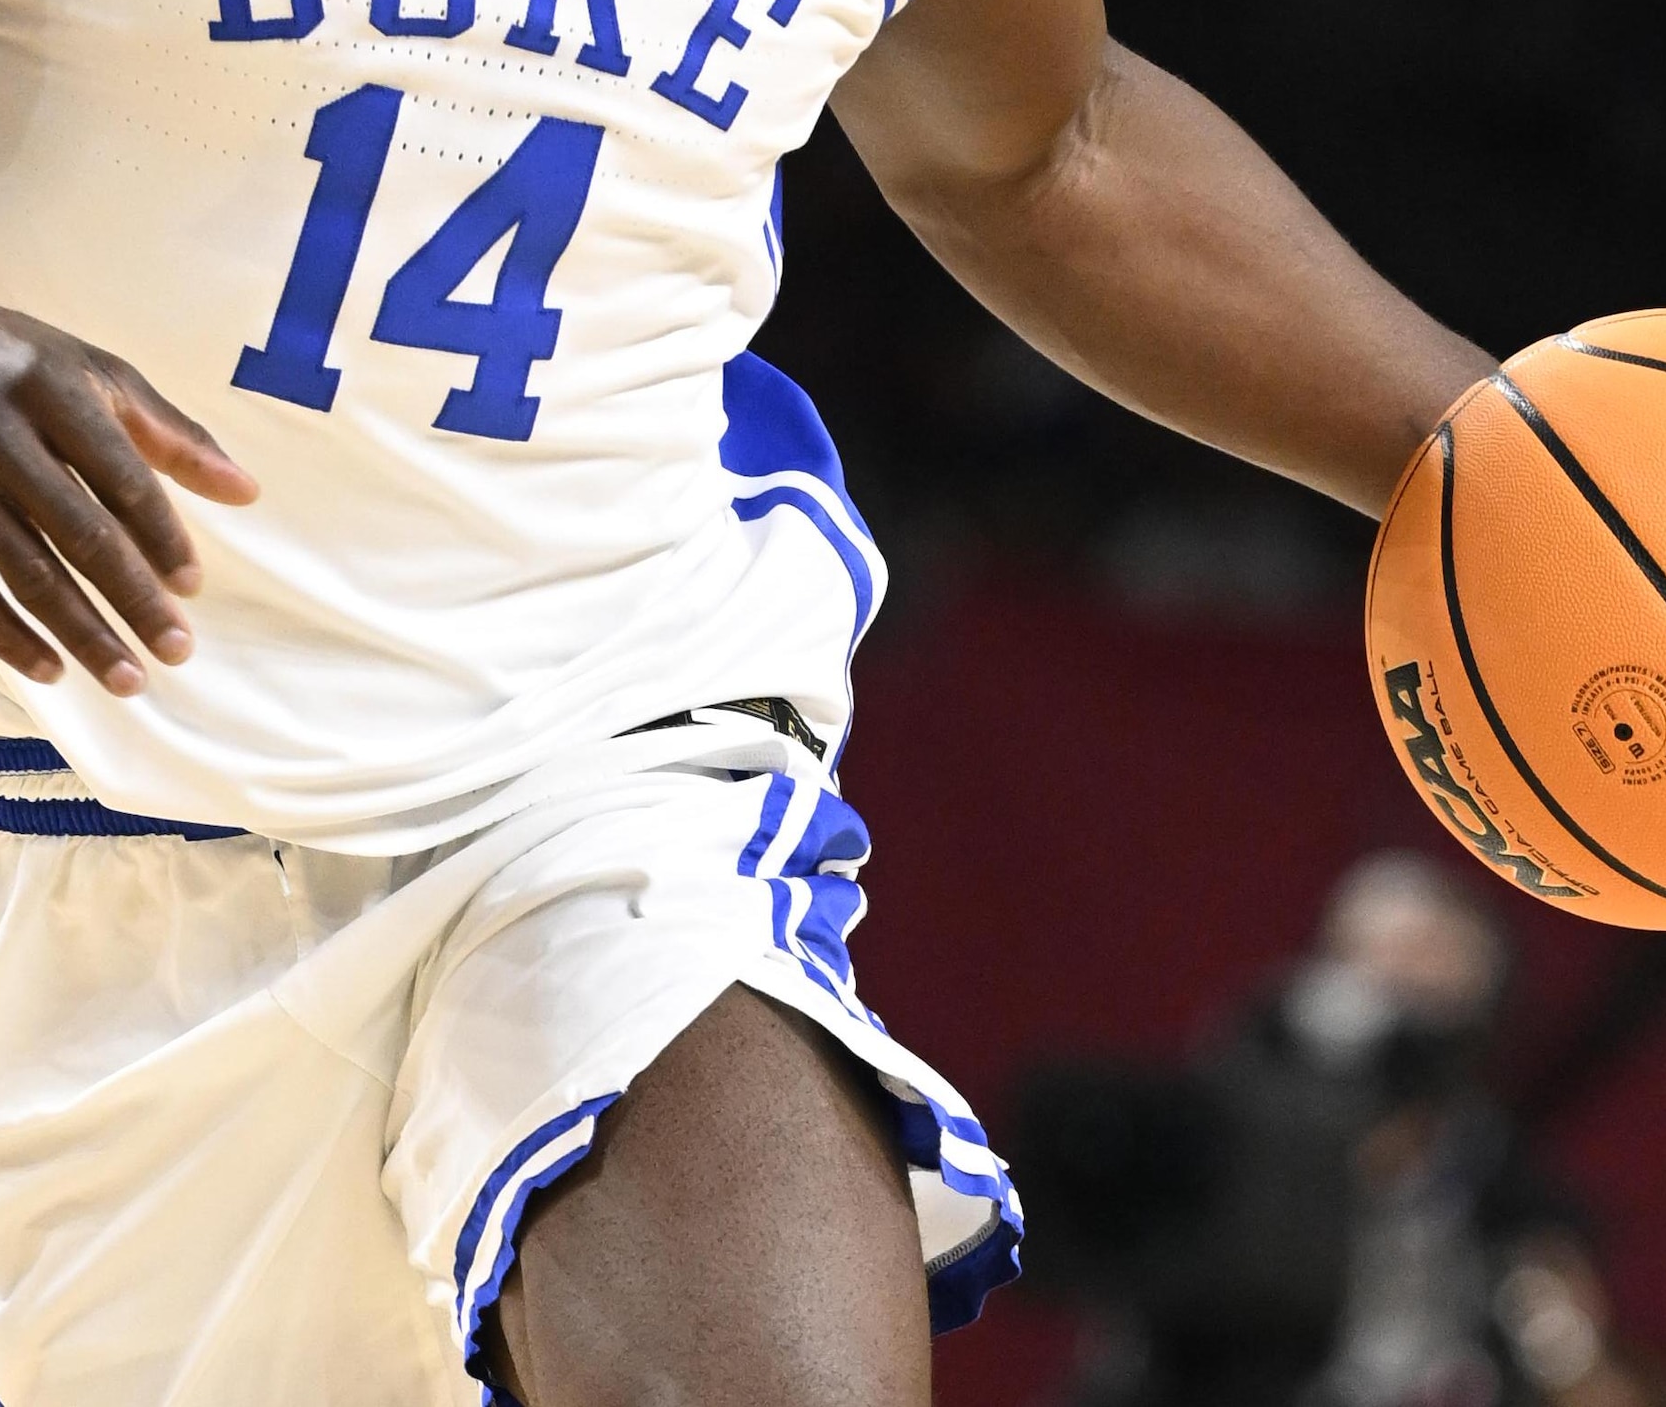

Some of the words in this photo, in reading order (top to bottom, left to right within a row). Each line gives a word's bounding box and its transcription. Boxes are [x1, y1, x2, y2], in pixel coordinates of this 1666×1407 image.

[230, 82, 606, 442] 14
[1426, 660, 1453, 736] BALL
[1576, 727, 1588, 737] 7
[1384, 660, 1586, 898] NCAA
[1450, 742, 1500, 815] GAME
[1585, 738, 1611, 769] SIZE
[1504, 819, 1601, 896] OFFICIAL
